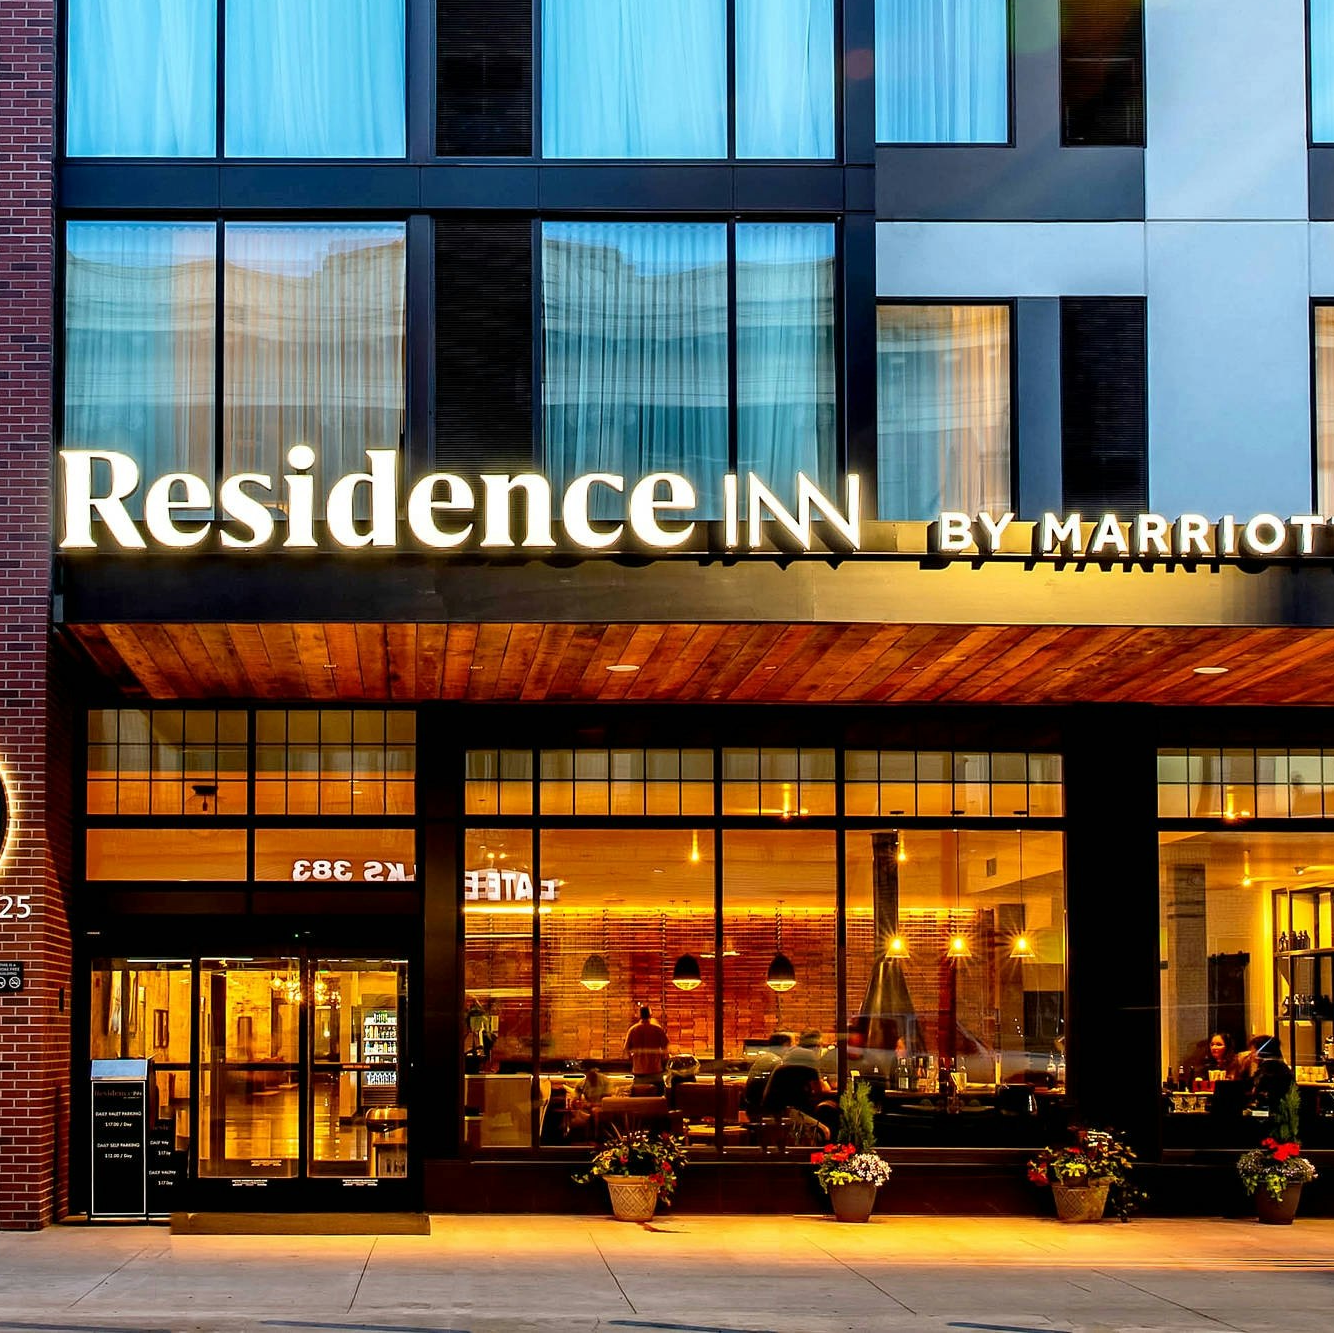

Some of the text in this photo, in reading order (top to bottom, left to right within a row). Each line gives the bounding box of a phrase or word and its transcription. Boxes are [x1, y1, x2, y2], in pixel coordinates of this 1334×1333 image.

[59, 445, 860, 551] Residence INN
[937, 512, 1015, 553] BY
